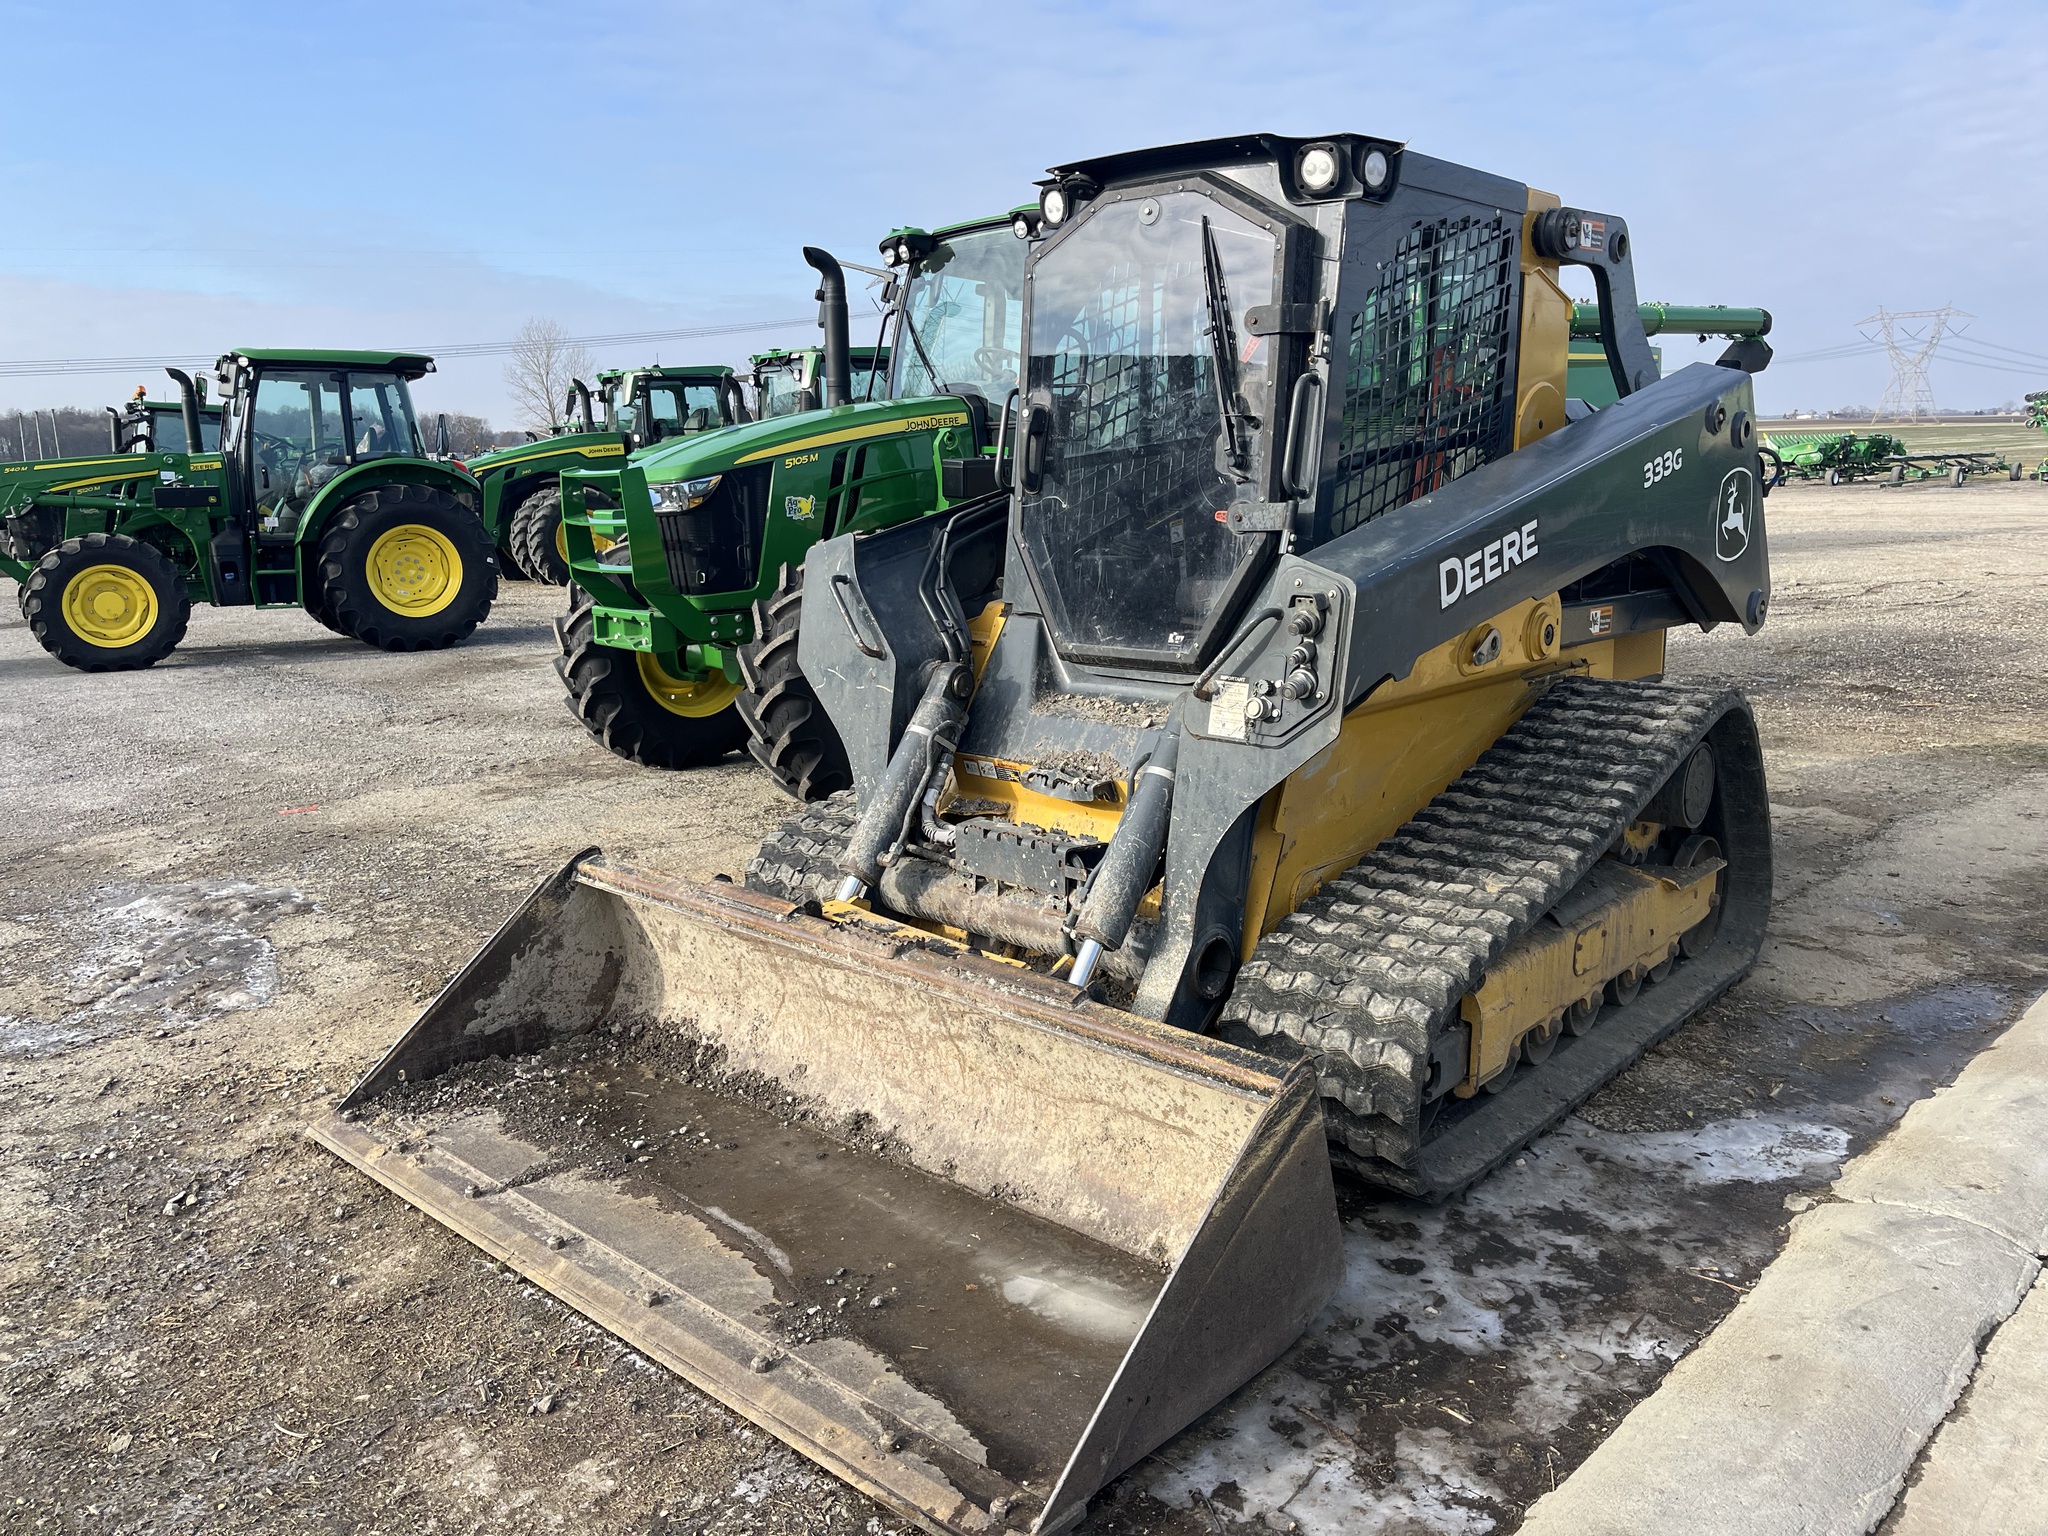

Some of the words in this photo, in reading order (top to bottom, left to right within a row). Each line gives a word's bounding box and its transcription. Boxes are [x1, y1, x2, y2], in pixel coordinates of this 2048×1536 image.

[905, 419, 930, 431] JOHN
[930, 416, 960, 427] DEERE
[785, 455, 808, 469] 5105
[809, 453, 819, 462] M
[1643, 447, 1683, 489] 333G
[1439, 518, 1539, 610] DEERE
